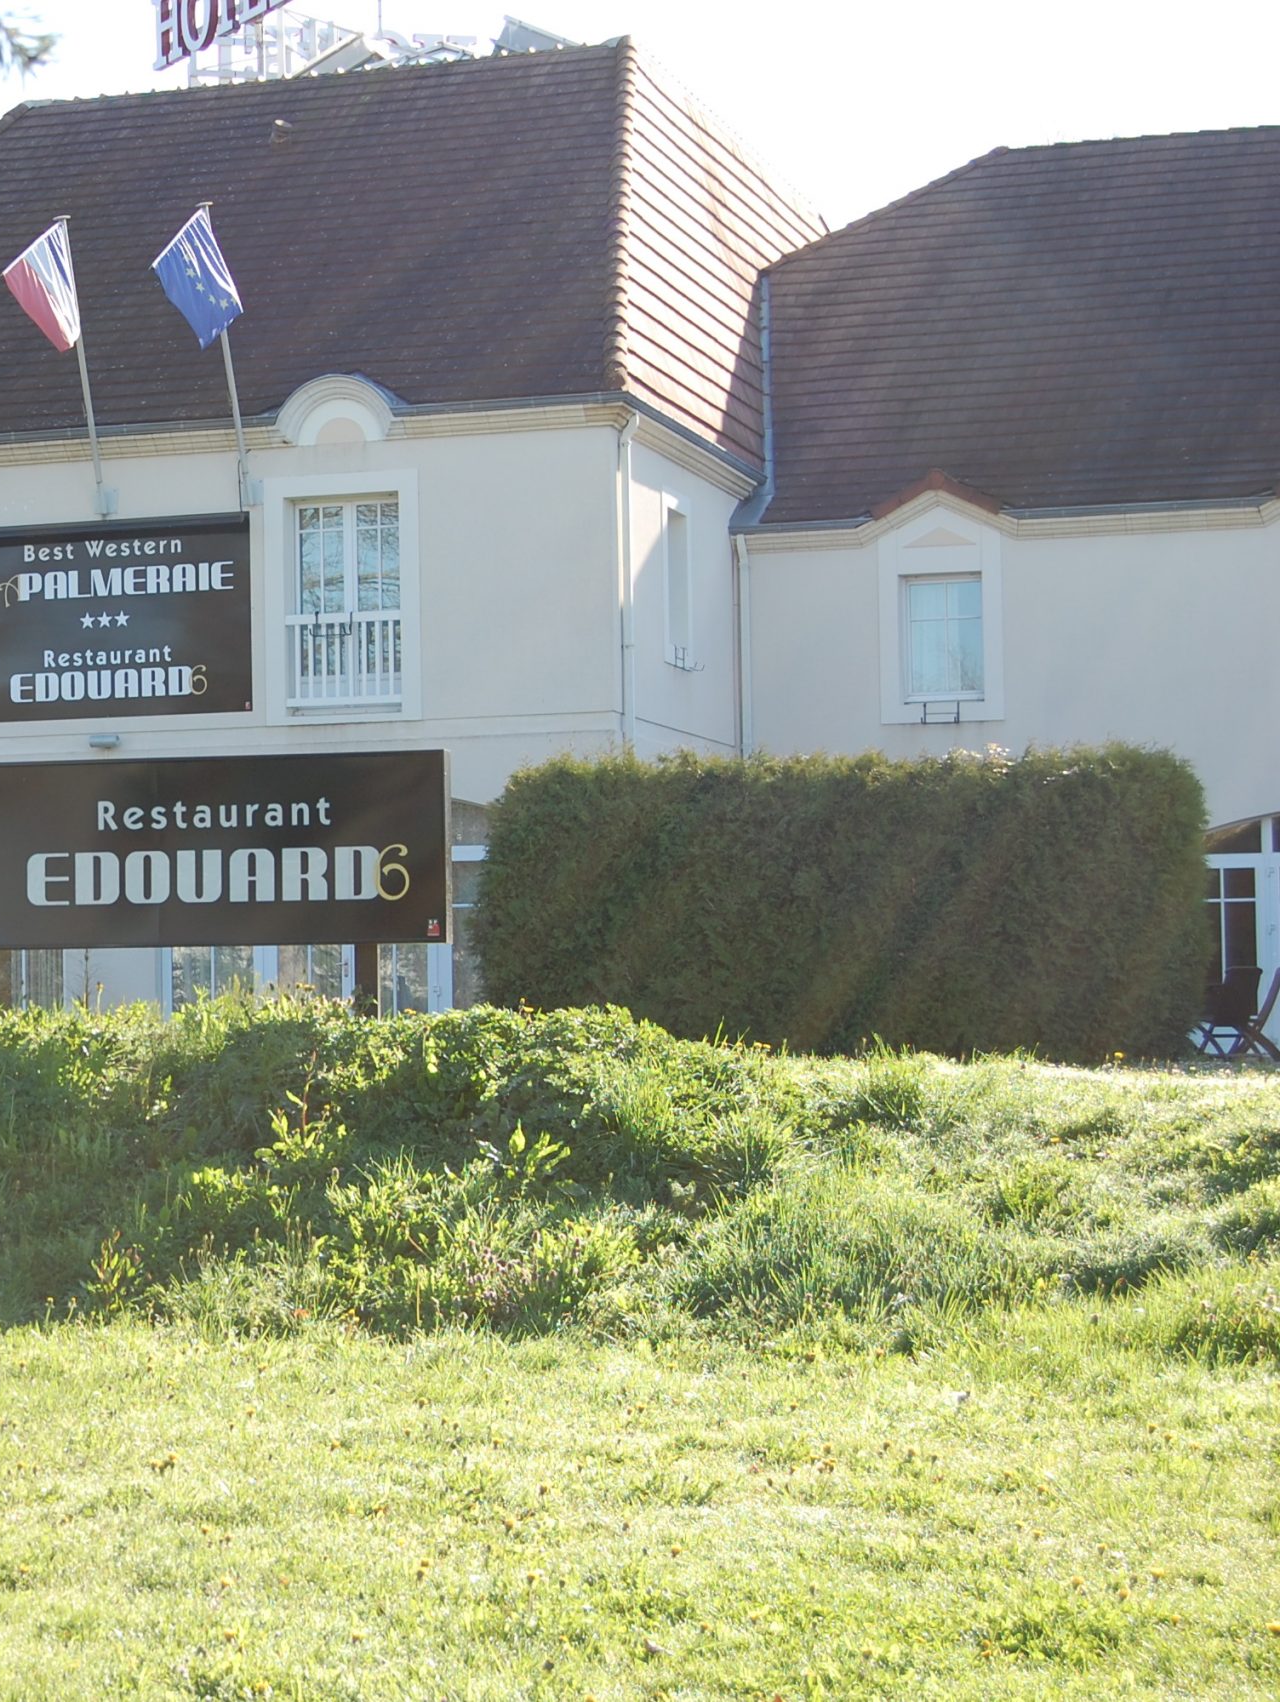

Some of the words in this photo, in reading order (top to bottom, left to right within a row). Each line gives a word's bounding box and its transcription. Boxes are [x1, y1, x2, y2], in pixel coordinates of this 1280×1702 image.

[23, 544, 74, 562] Best
[85, 538, 182, 558] Western
[18, 560, 234, 602] PALMERAIE
[43, 645, 172, 668] Restaurant
[10, 665, 193, 703] EDOUARD
[97, 797, 331, 831] Restaurant
[26, 845, 380, 906] EDOUARD
